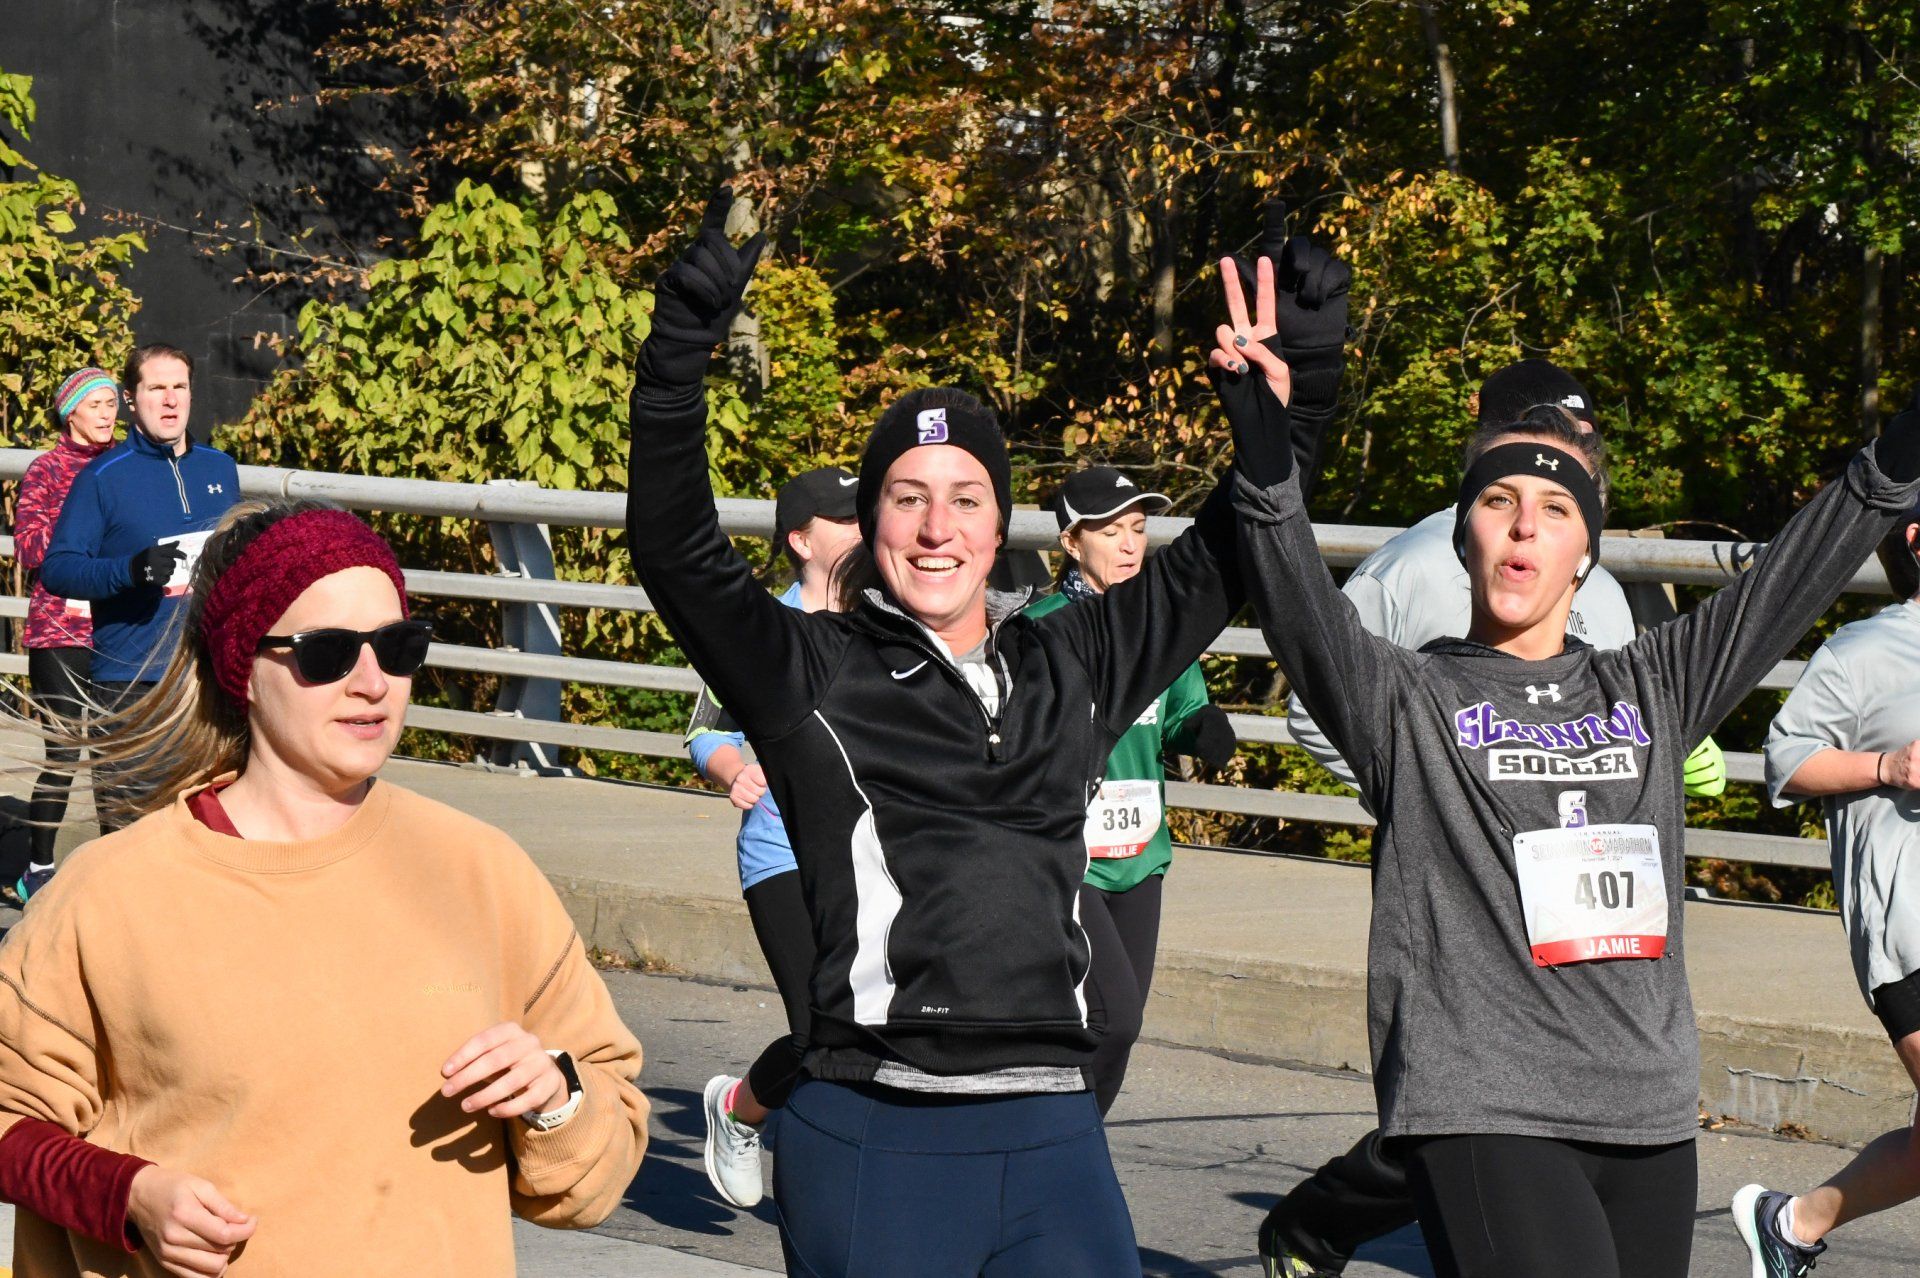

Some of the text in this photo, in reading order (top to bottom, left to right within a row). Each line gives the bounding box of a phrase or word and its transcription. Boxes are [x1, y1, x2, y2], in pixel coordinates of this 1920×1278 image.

[917, 408, 949, 444] S
[1498, 753, 1632, 775] SOCCER
[1102, 806, 1142, 831] 334
[1106, 845, 1138, 857] JULIE
[1575, 871, 1634, 909] 407
[1584, 937, 1641, 956] JAMIE
